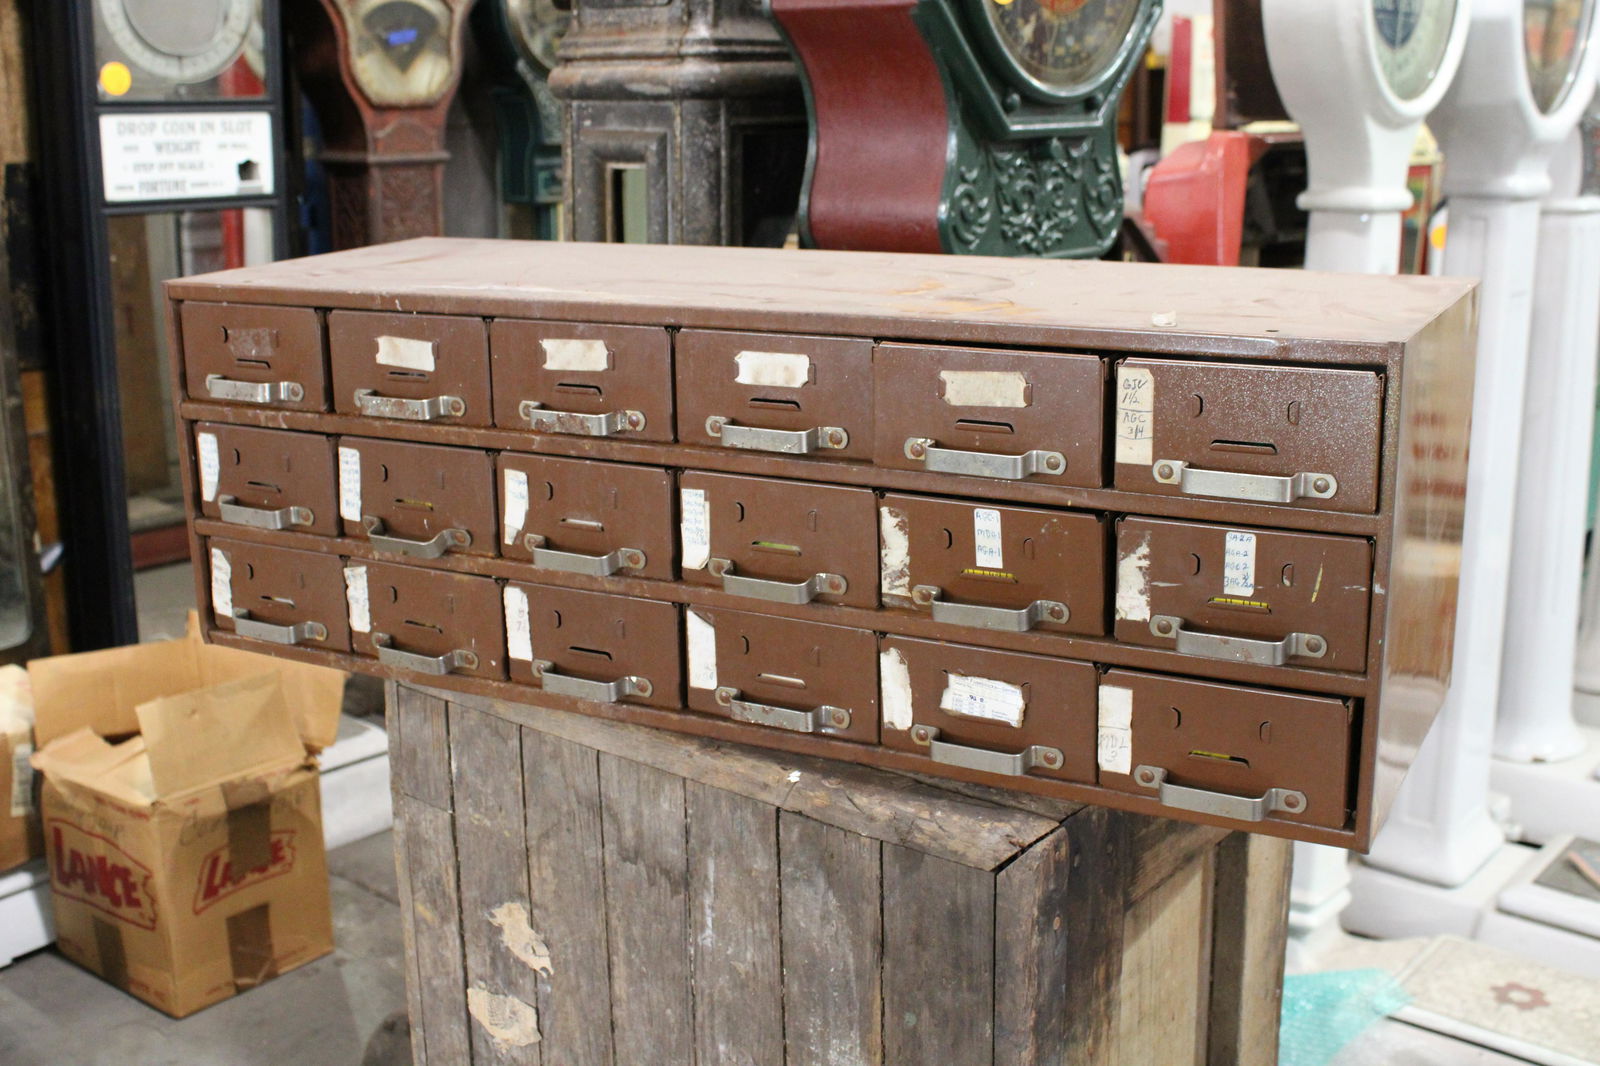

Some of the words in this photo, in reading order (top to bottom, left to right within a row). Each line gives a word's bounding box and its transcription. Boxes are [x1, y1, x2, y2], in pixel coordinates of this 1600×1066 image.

[116, 120, 157, 136] DROP
[162, 120, 195, 135] COIN
[200, 120, 215, 134] IN
[220, 119, 252, 135] SLOT
[153, 140, 201, 155] WEIGHT
[53, 826, 142, 909] LANCE
